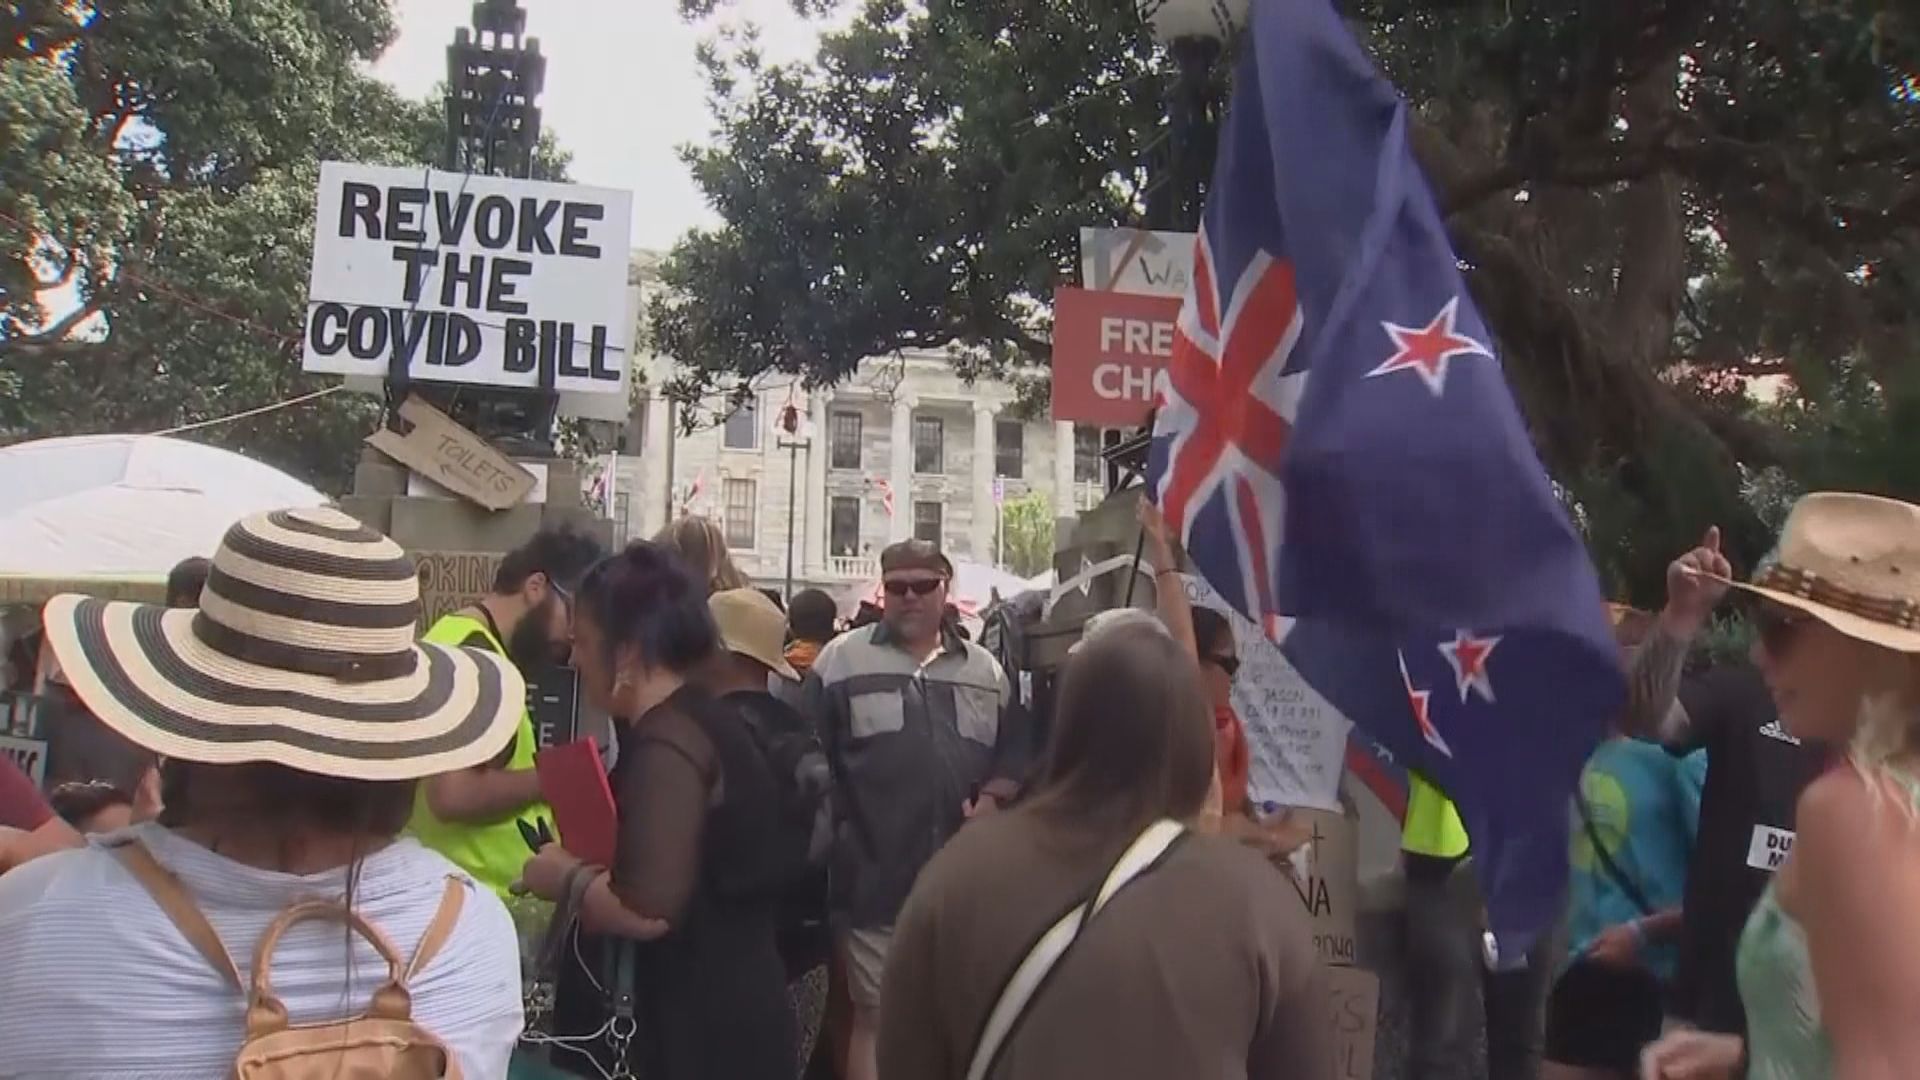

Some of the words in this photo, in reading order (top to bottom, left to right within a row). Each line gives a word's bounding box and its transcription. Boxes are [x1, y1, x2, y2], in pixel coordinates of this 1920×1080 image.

[339, 181, 604, 259] REVOKE
[392, 246, 533, 315] THE
[310, 302, 482, 367] COVID
[503, 317, 621, 388] BILL
[436, 433, 515, 492] TOILETS
